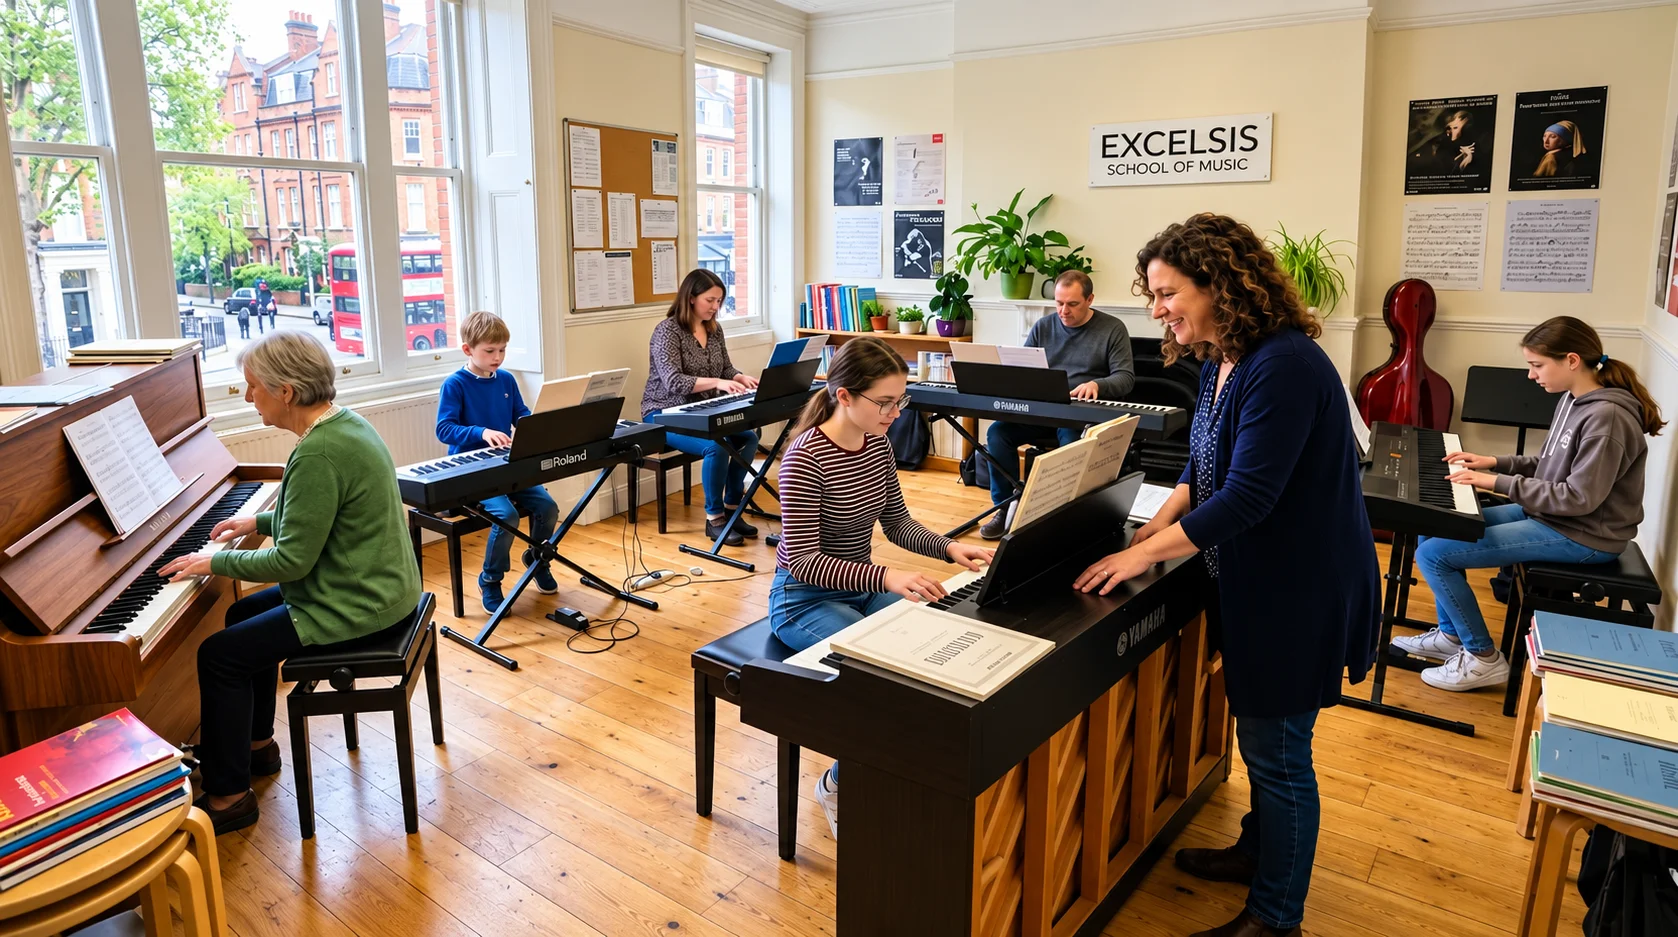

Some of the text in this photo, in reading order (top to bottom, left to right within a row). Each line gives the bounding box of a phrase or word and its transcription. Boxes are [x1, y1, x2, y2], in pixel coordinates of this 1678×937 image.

[1102, 125, 1259, 159] EXCELSIS
[1107, 158, 1248, 176] SCHOOL OF MUSIC
[553, 449, 587, 468] Roland
[1129, 603, 1166, 648] YAMAHA
